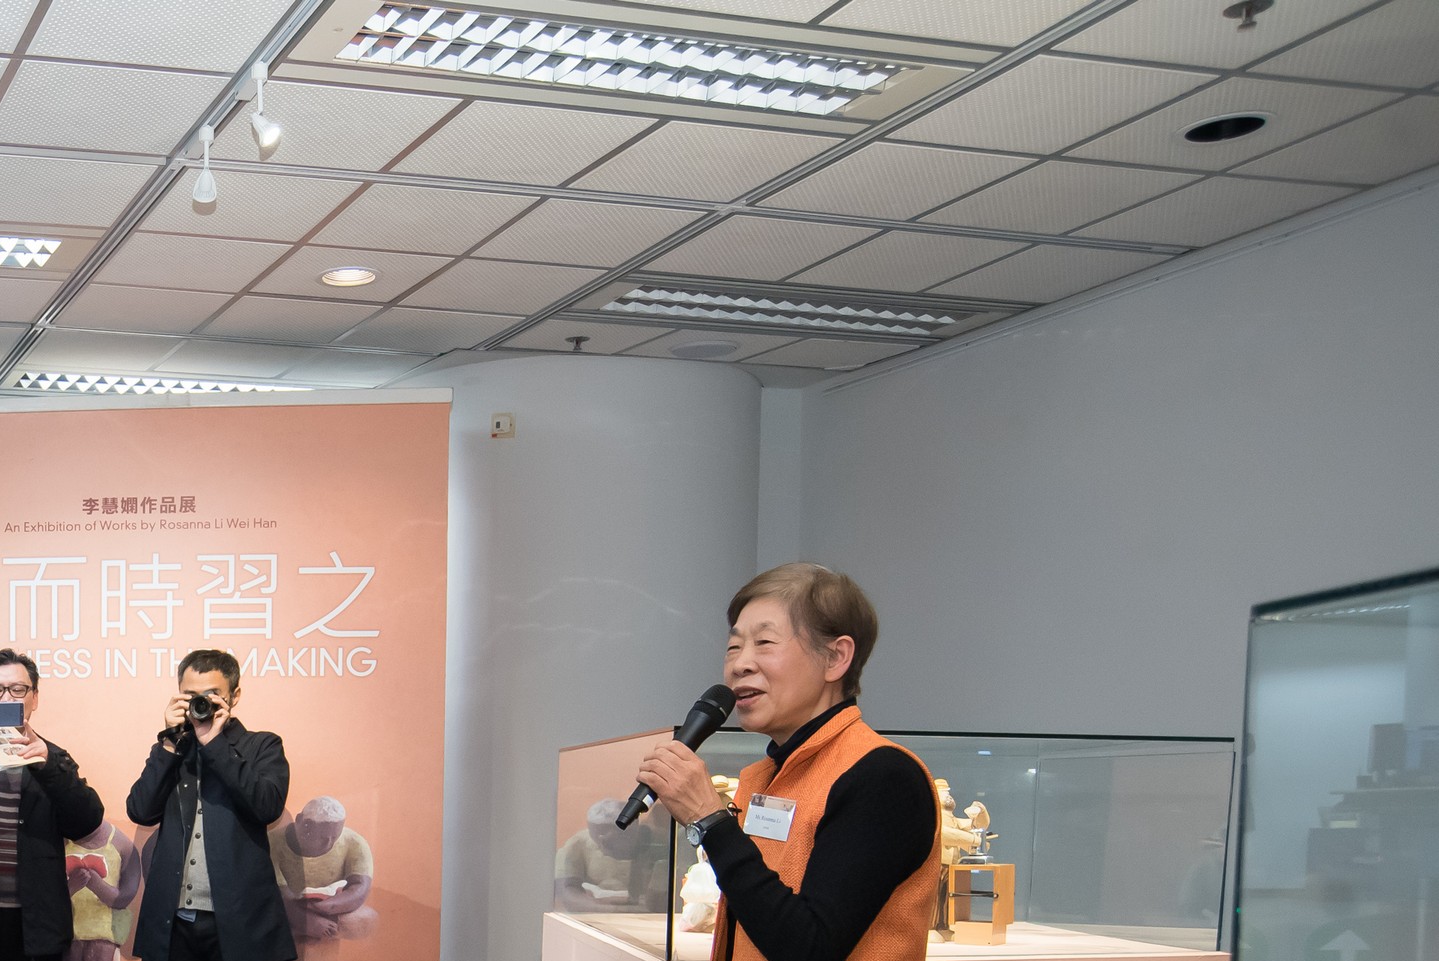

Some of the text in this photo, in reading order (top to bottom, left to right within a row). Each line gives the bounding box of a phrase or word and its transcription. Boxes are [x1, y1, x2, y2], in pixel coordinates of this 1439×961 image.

[82, 495, 197, 515] 李慧嫻作品展
[4, 517, 278, 534] An Exhibition of Works by Rosanna Li Wei Han
[105, 648, 137, 678] IN
[150, 647, 213, 678] TH
[105, 648, 137, 678] IN
